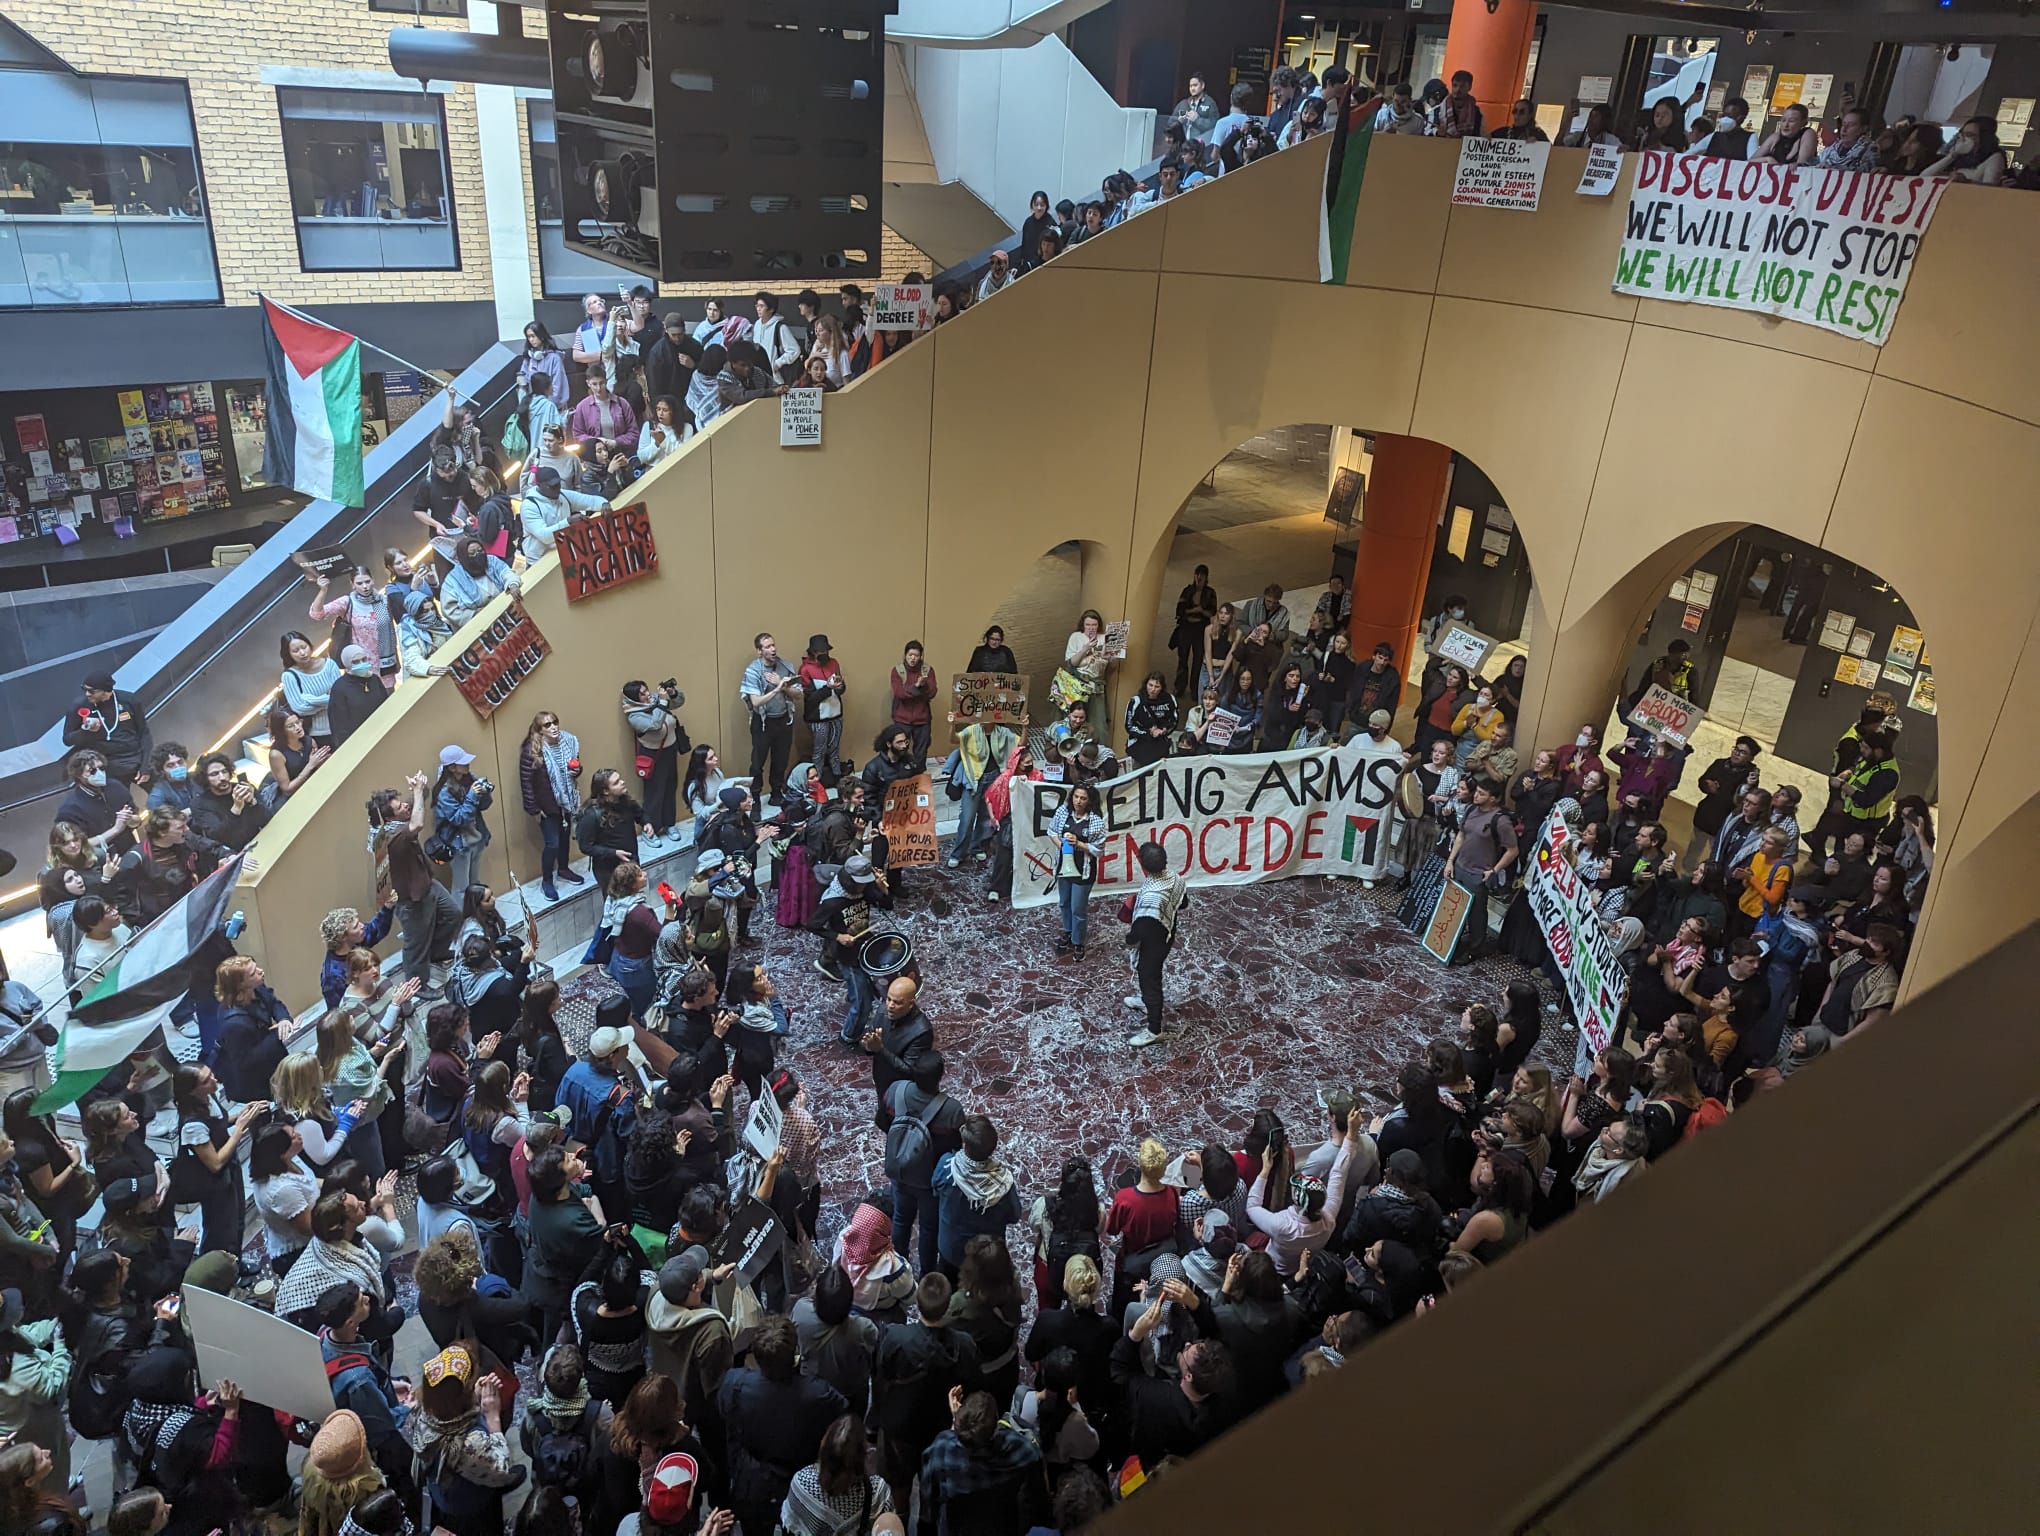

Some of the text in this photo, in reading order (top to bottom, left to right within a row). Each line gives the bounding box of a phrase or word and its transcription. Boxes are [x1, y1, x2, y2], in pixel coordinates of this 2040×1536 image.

[1467, 140, 1522, 155] UNIMELB:
[1592, 147, 1607, 157] FREE
[1496, 155, 1530, 164] CRESCAM
[1462, 168, 1535, 180] GROW IN ESTEEM
[1458, 178, 1536, 190] OF FUTURE ZIONIST
[1457, 186, 1536, 198] COLONIAL RACIST WAR
[1815, 169, 1950, 229] DIVEST
[1452, 195, 1536, 208] CRIMINAL GENERATIONS
[1626, 199, 1921, 280] WE WILL NOT STOP
[894, 287, 921, 302] BLOOD
[1616, 247, 1899, 338] WE WILL NOT REST
[876, 300, 889, 311] ON
[876, 311, 914, 323] DEGREE
[785, 391, 817, 400] THE POWER
[793, 415, 813, 424] PEOPLE
[795, 423, 819, 433] POWER
[300, 554, 344, 568] CEASEFIRE
[450, 603, 524, 682] NO MORE
[1441, 644, 1478, 664] GENOCIDE
[484, 640, 543, 705] UNIMELB
[959, 677, 989, 691] STOP
[960, 694, 1025, 720] GENOCIDE!
[1652, 688, 1696, 715] NO MORE
[1649, 700, 1688, 728] BLOOD
[1647, 717, 1665, 731] OUR
[891, 782, 919, 798] THERE
[1033, 756, 1402, 838] BEING ARMS
[896, 799, 909, 811] IS
[884, 809, 931, 829] BLOOD
[889, 833, 932, 845] ON YOUR
[1097, 811, 1329, 885] ENOCIDE
[890, 848, 936, 865] DEGREES
[753, 1113, 767, 1137] NOW.
[737, 1218, 775, 1271] CEASEFIRE
[742, 1226, 759, 1248] NOW
